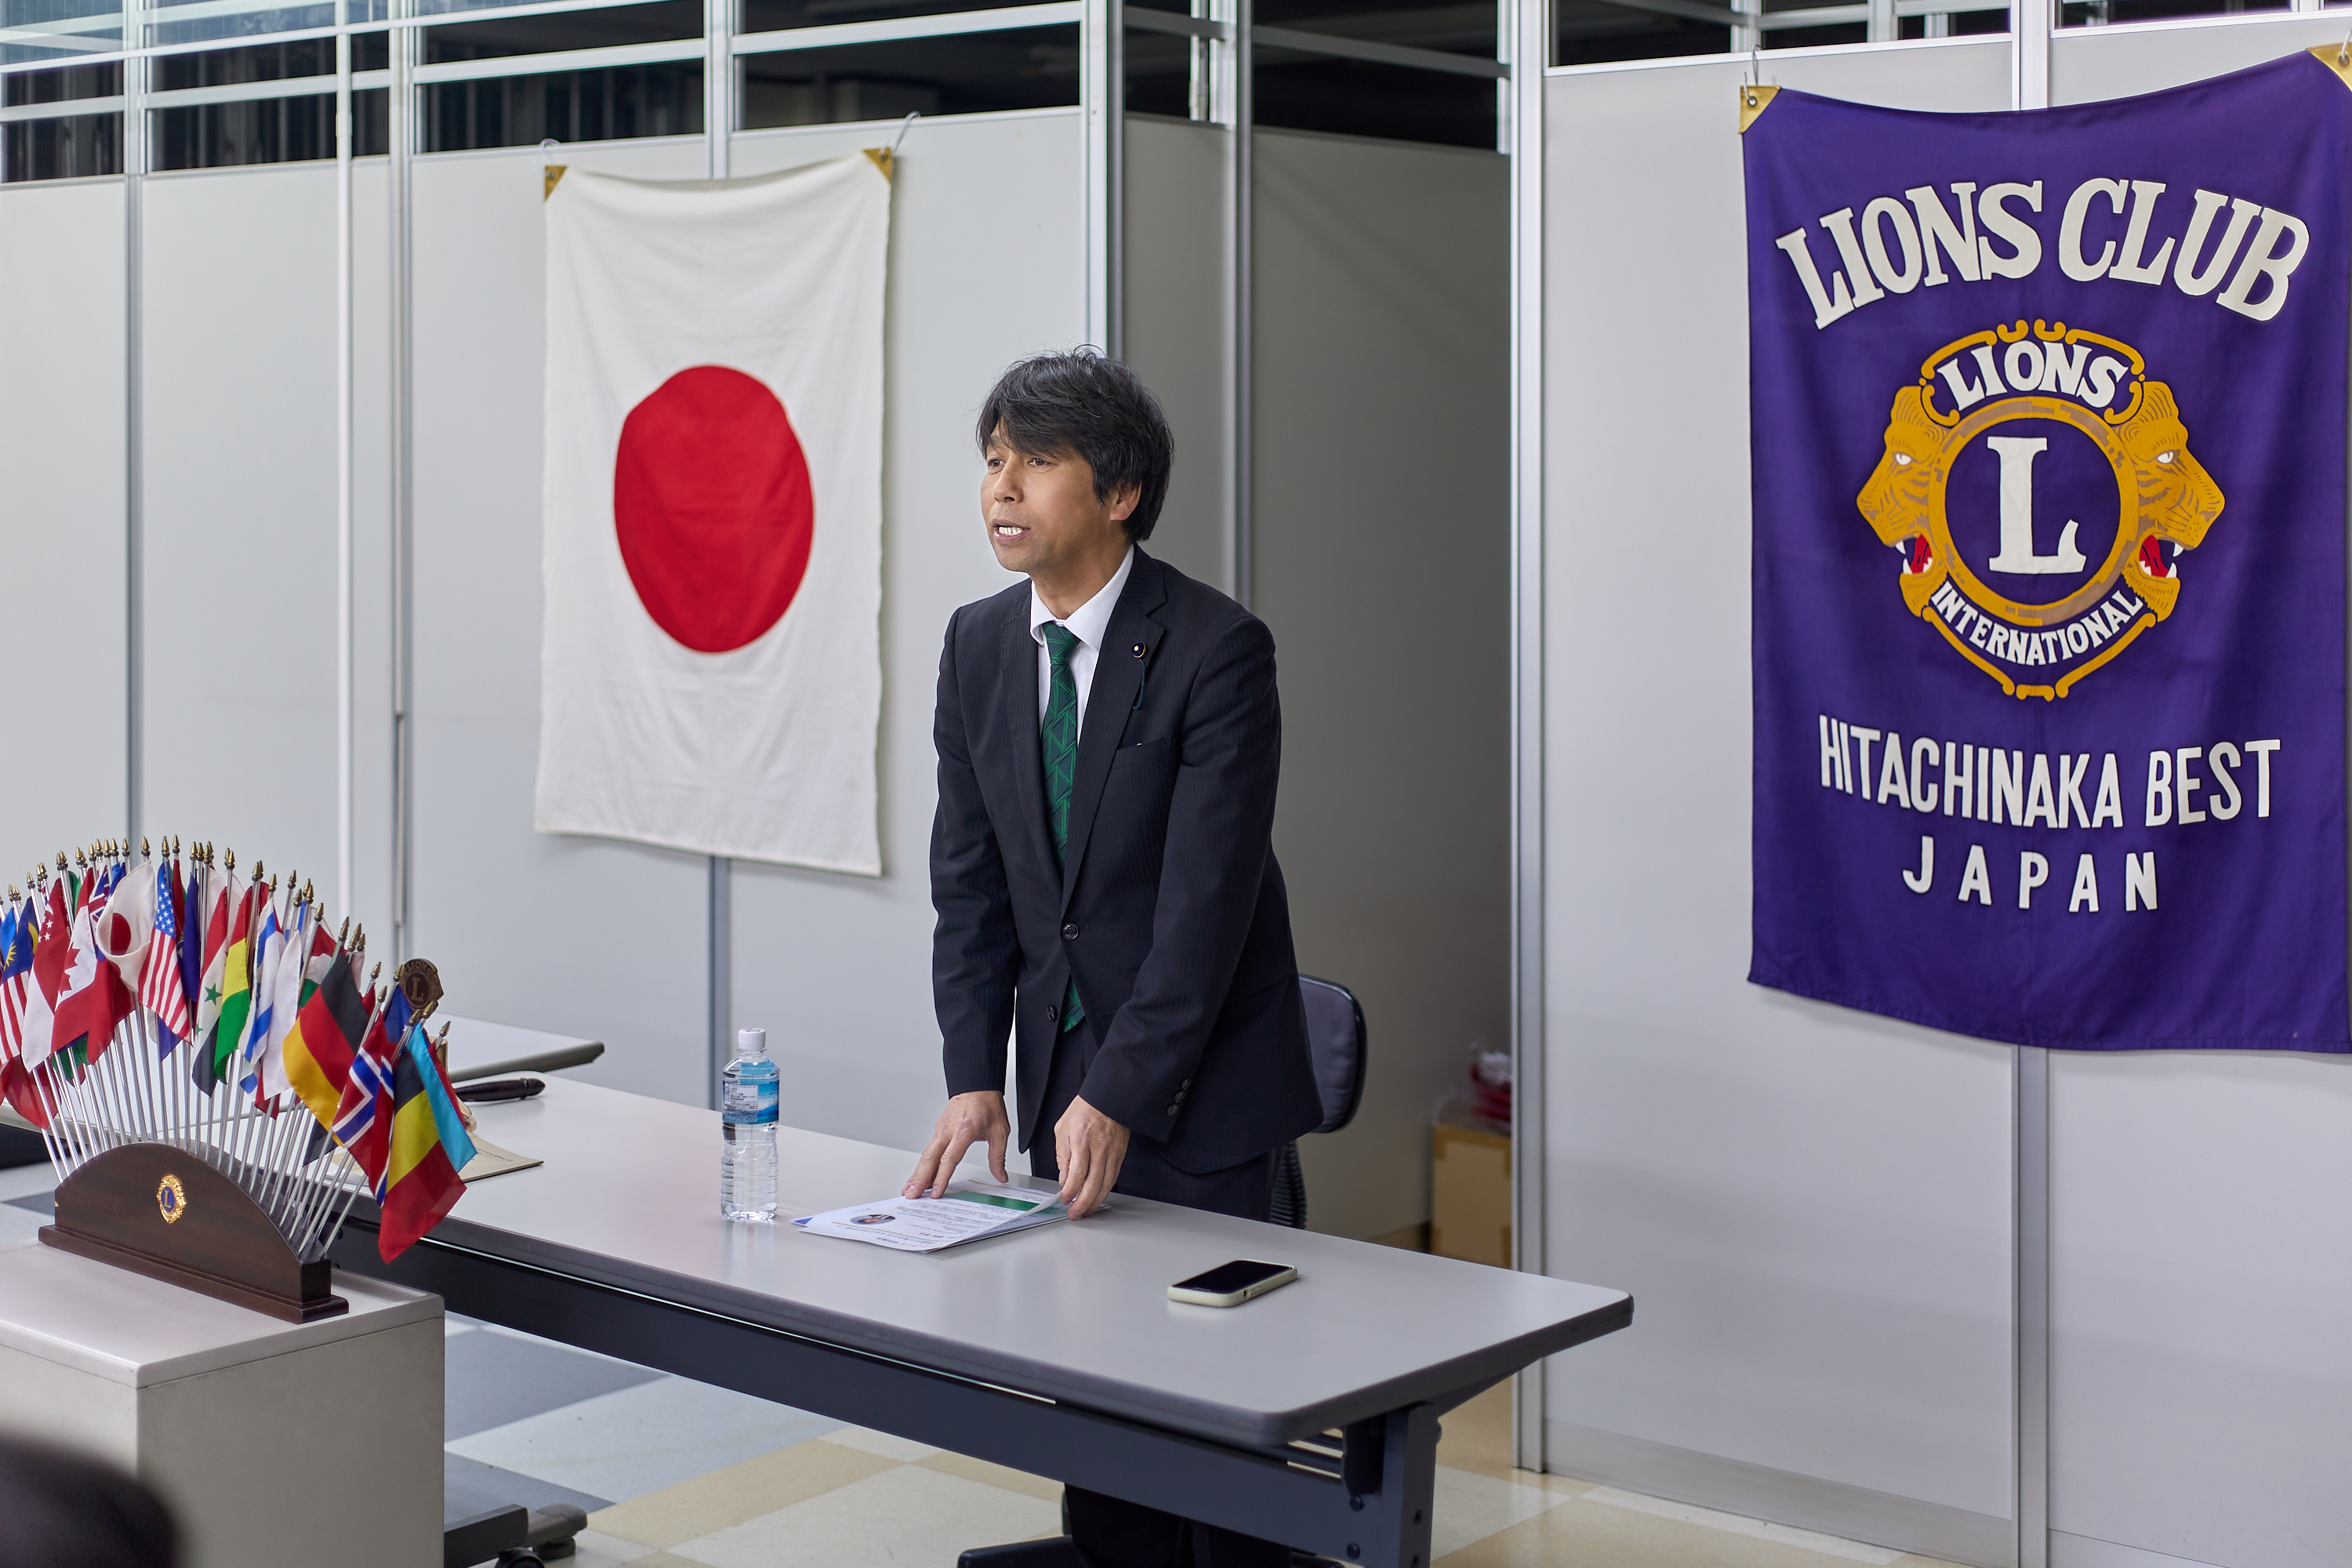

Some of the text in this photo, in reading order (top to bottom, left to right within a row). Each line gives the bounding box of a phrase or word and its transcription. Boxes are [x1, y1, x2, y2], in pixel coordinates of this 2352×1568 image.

[1776, 178, 2309, 329] LIONS CLUB
[1937, 340, 2129, 411] LIONS
[1987, 436, 2086, 574] L
[1930, 580, 2144, 666] INTERNATIONAL
[1820, 714, 2281, 828] HITACHINAKA BEST
[1903, 835, 2158, 913] JAPAN
